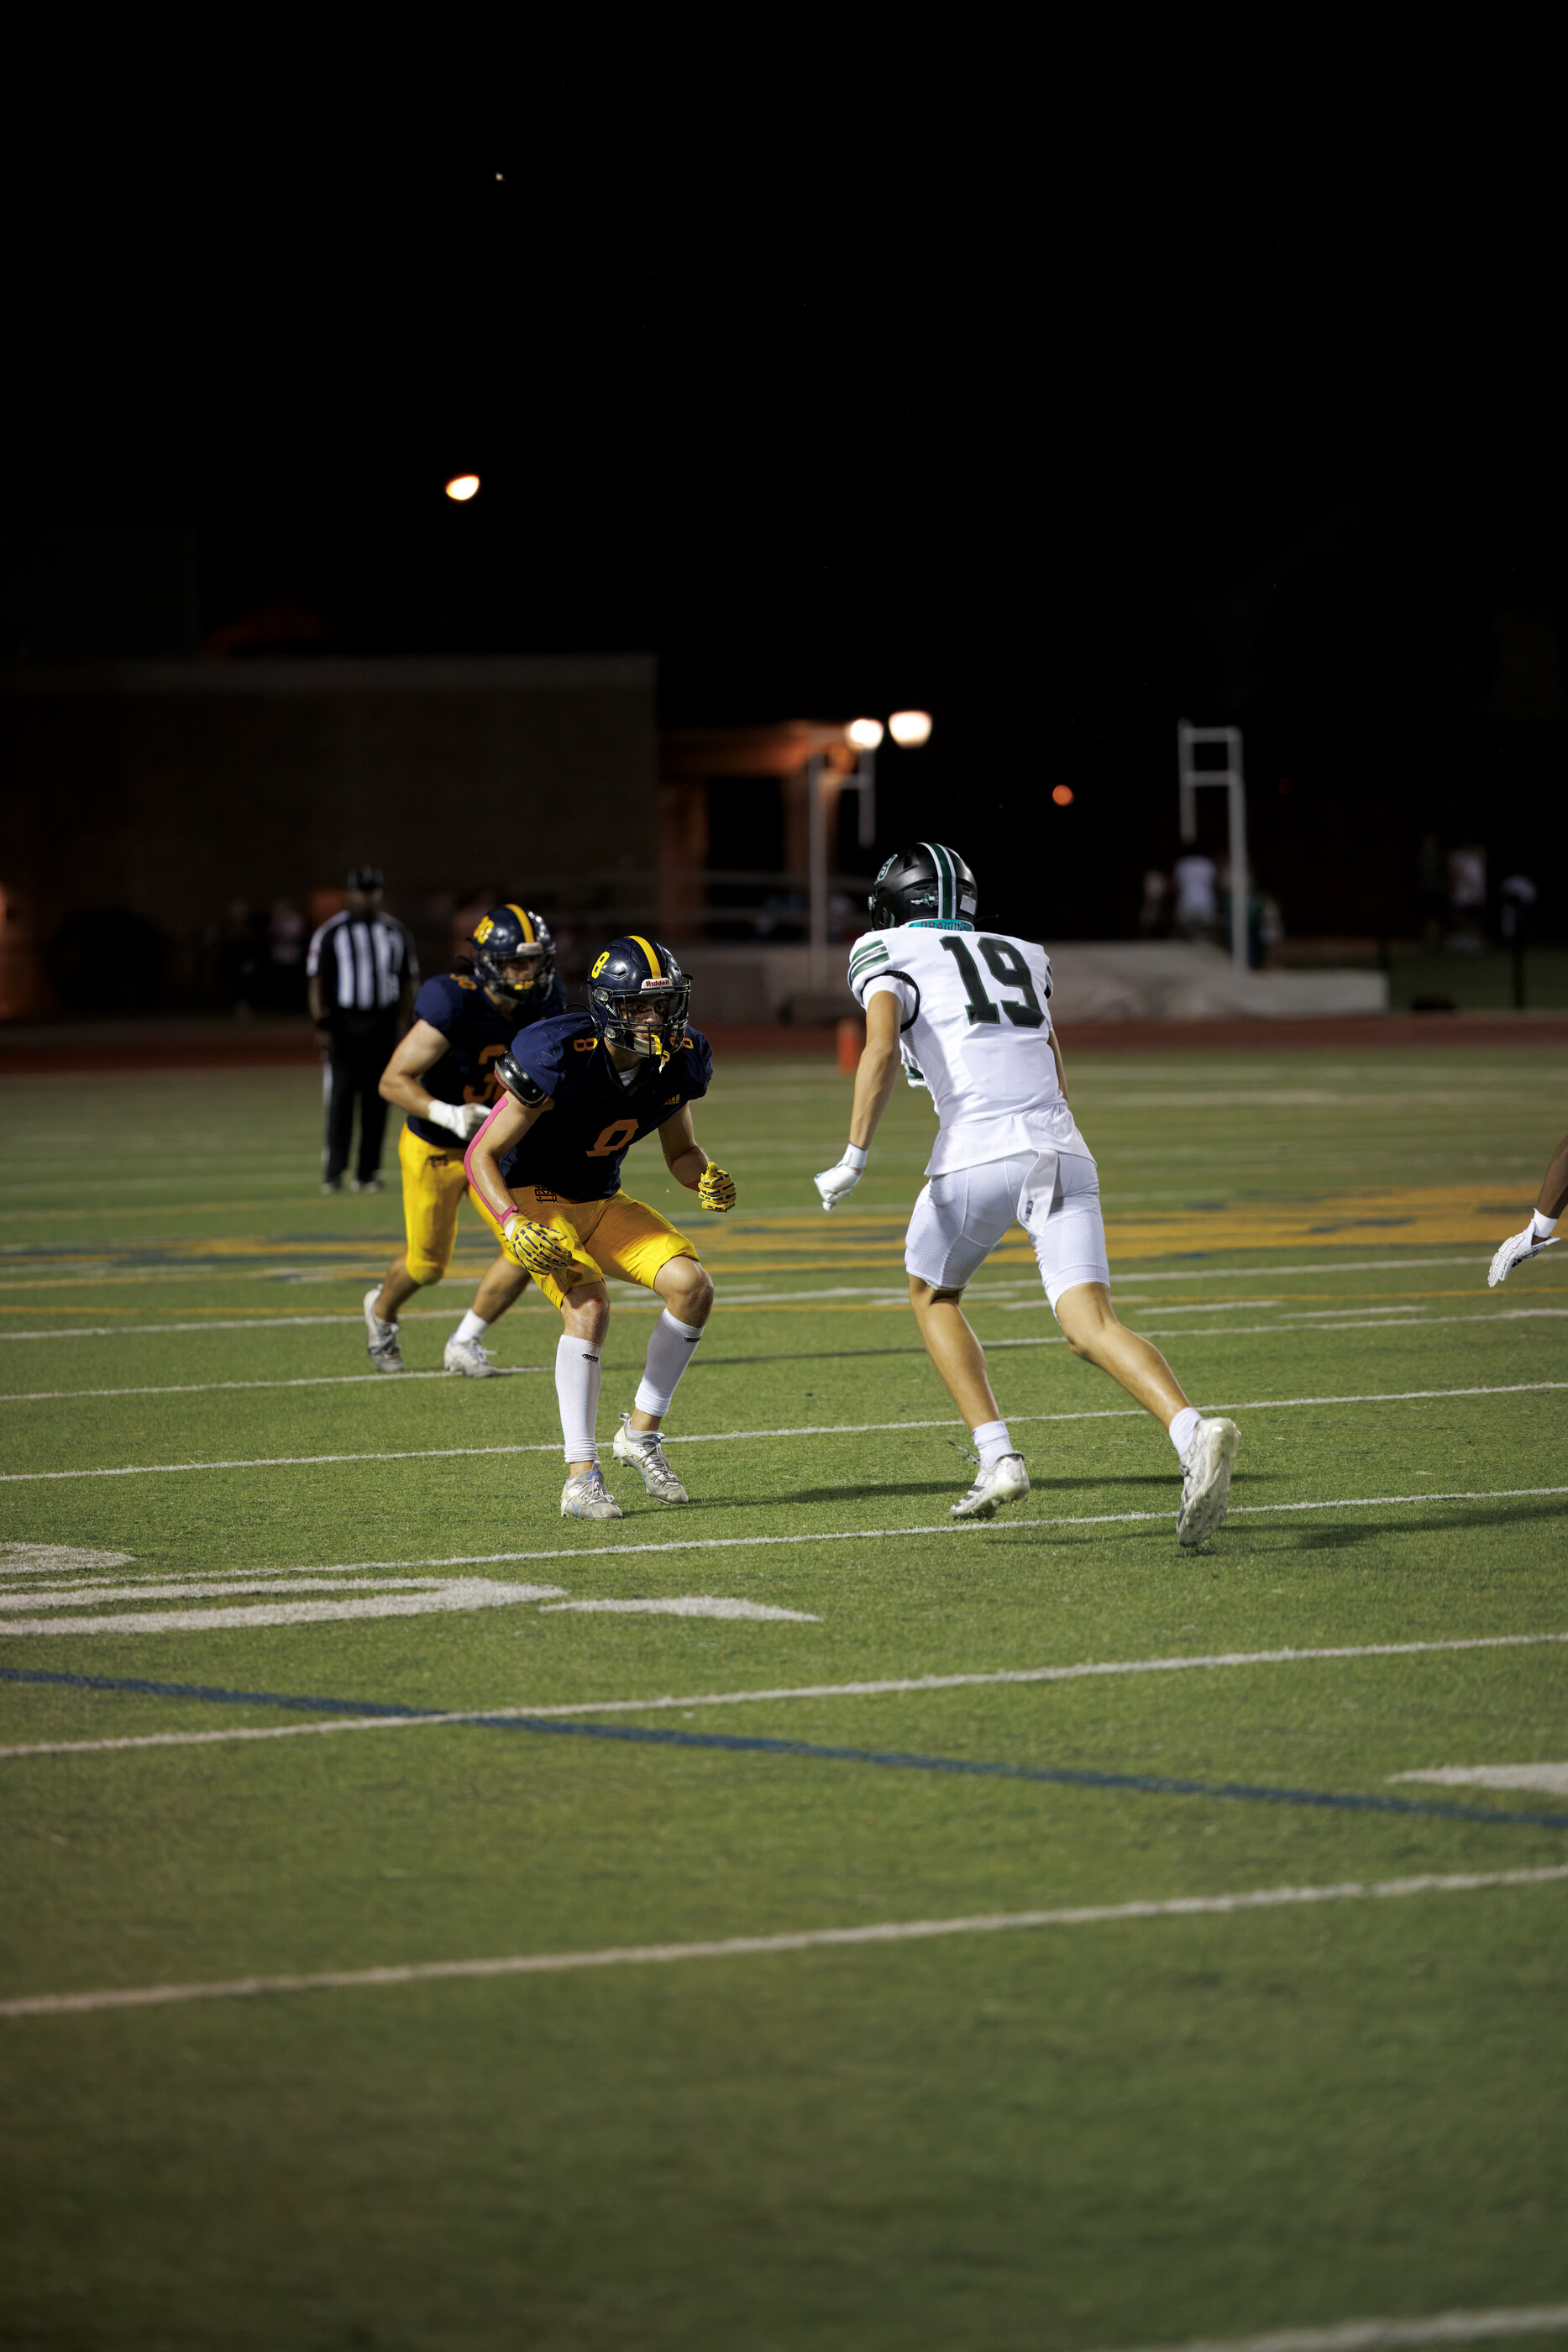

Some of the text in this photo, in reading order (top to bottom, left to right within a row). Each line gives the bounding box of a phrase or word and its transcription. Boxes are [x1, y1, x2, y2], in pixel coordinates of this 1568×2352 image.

[591, 951, 611, 979] 8
[646, 979, 670, 988] Riddell
[940, 936, 1046, 1029] 19
[574, 1037, 599, 1053] 8
[462, 1042, 509, 1105] 3
